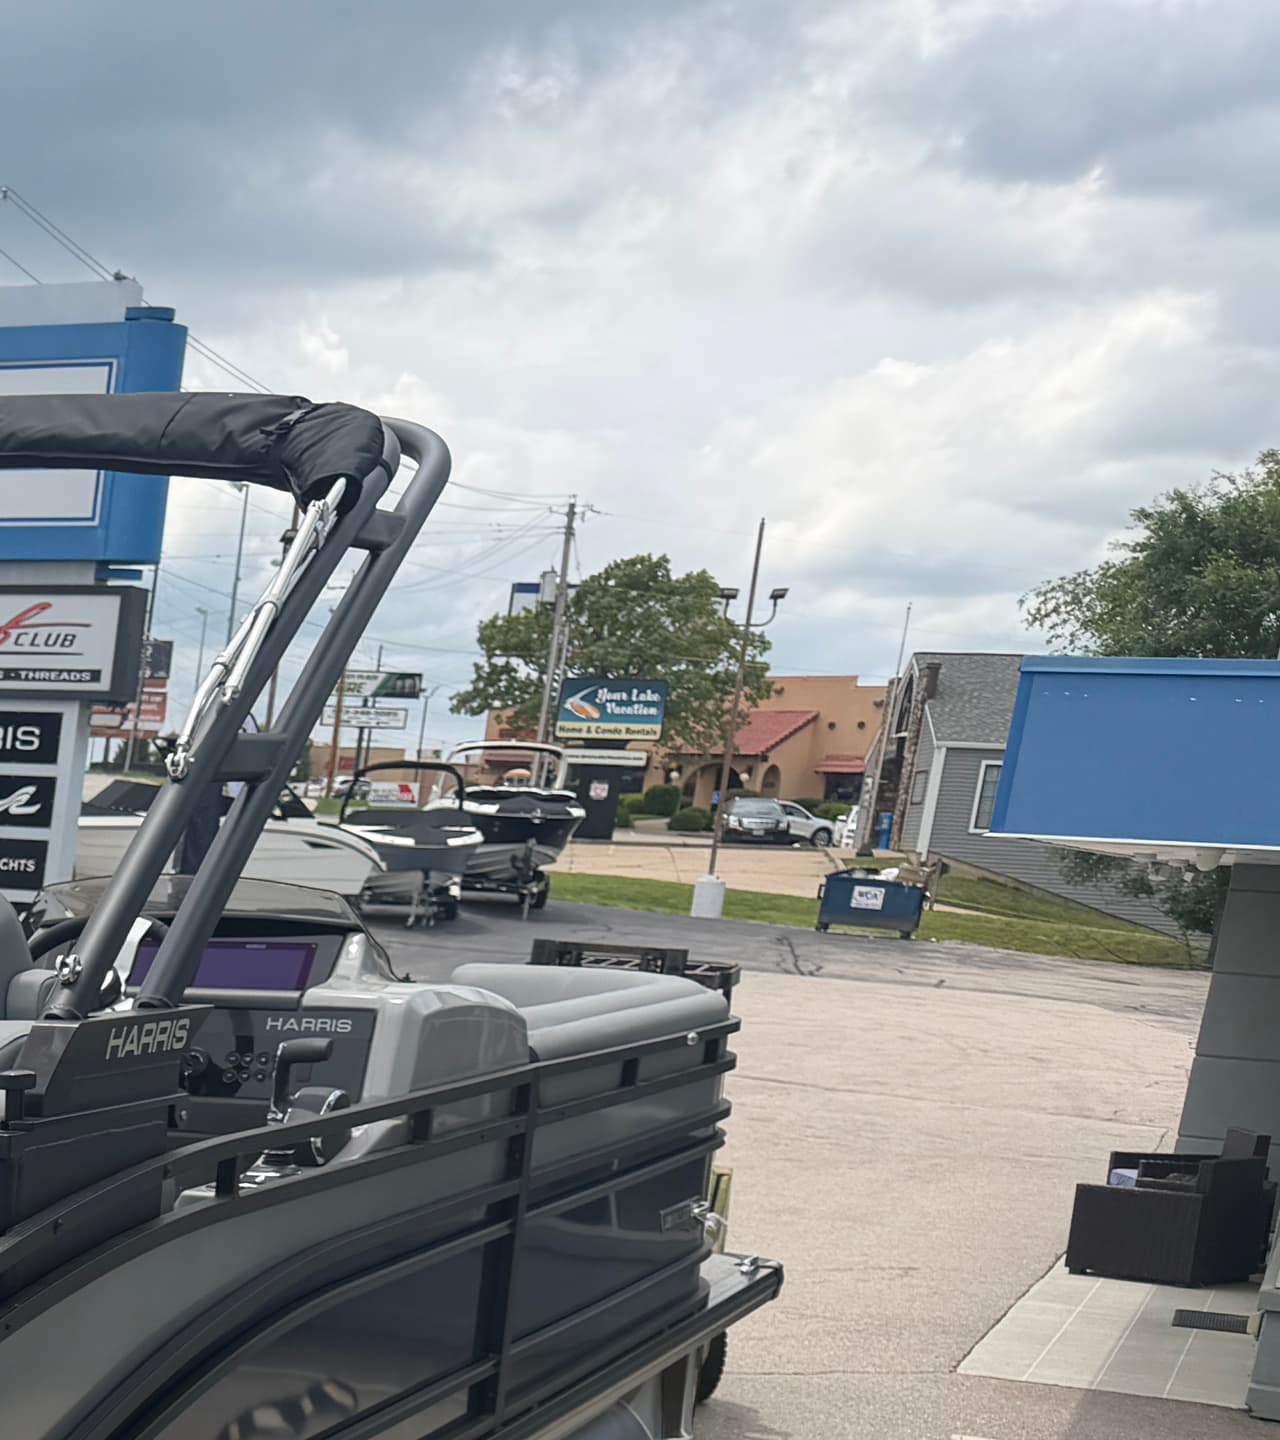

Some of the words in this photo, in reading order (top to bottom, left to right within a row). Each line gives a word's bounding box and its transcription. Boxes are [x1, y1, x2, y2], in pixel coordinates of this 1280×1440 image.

[13, 631, 77, 648] CLUB
[20, 670, 91, 682] THREADS
[595, 687, 628, 704] Your
[631, 687, 662, 703] Lake
[606, 702, 658, 716] Vacation
[559, 725, 583, 734] Home
[595, 726, 623, 735] Condo
[625, 727, 657, 737] Rentals
[265, 1017, 353, 1033] HARRIS
[105, 1018, 190, 1060] HARRIS
